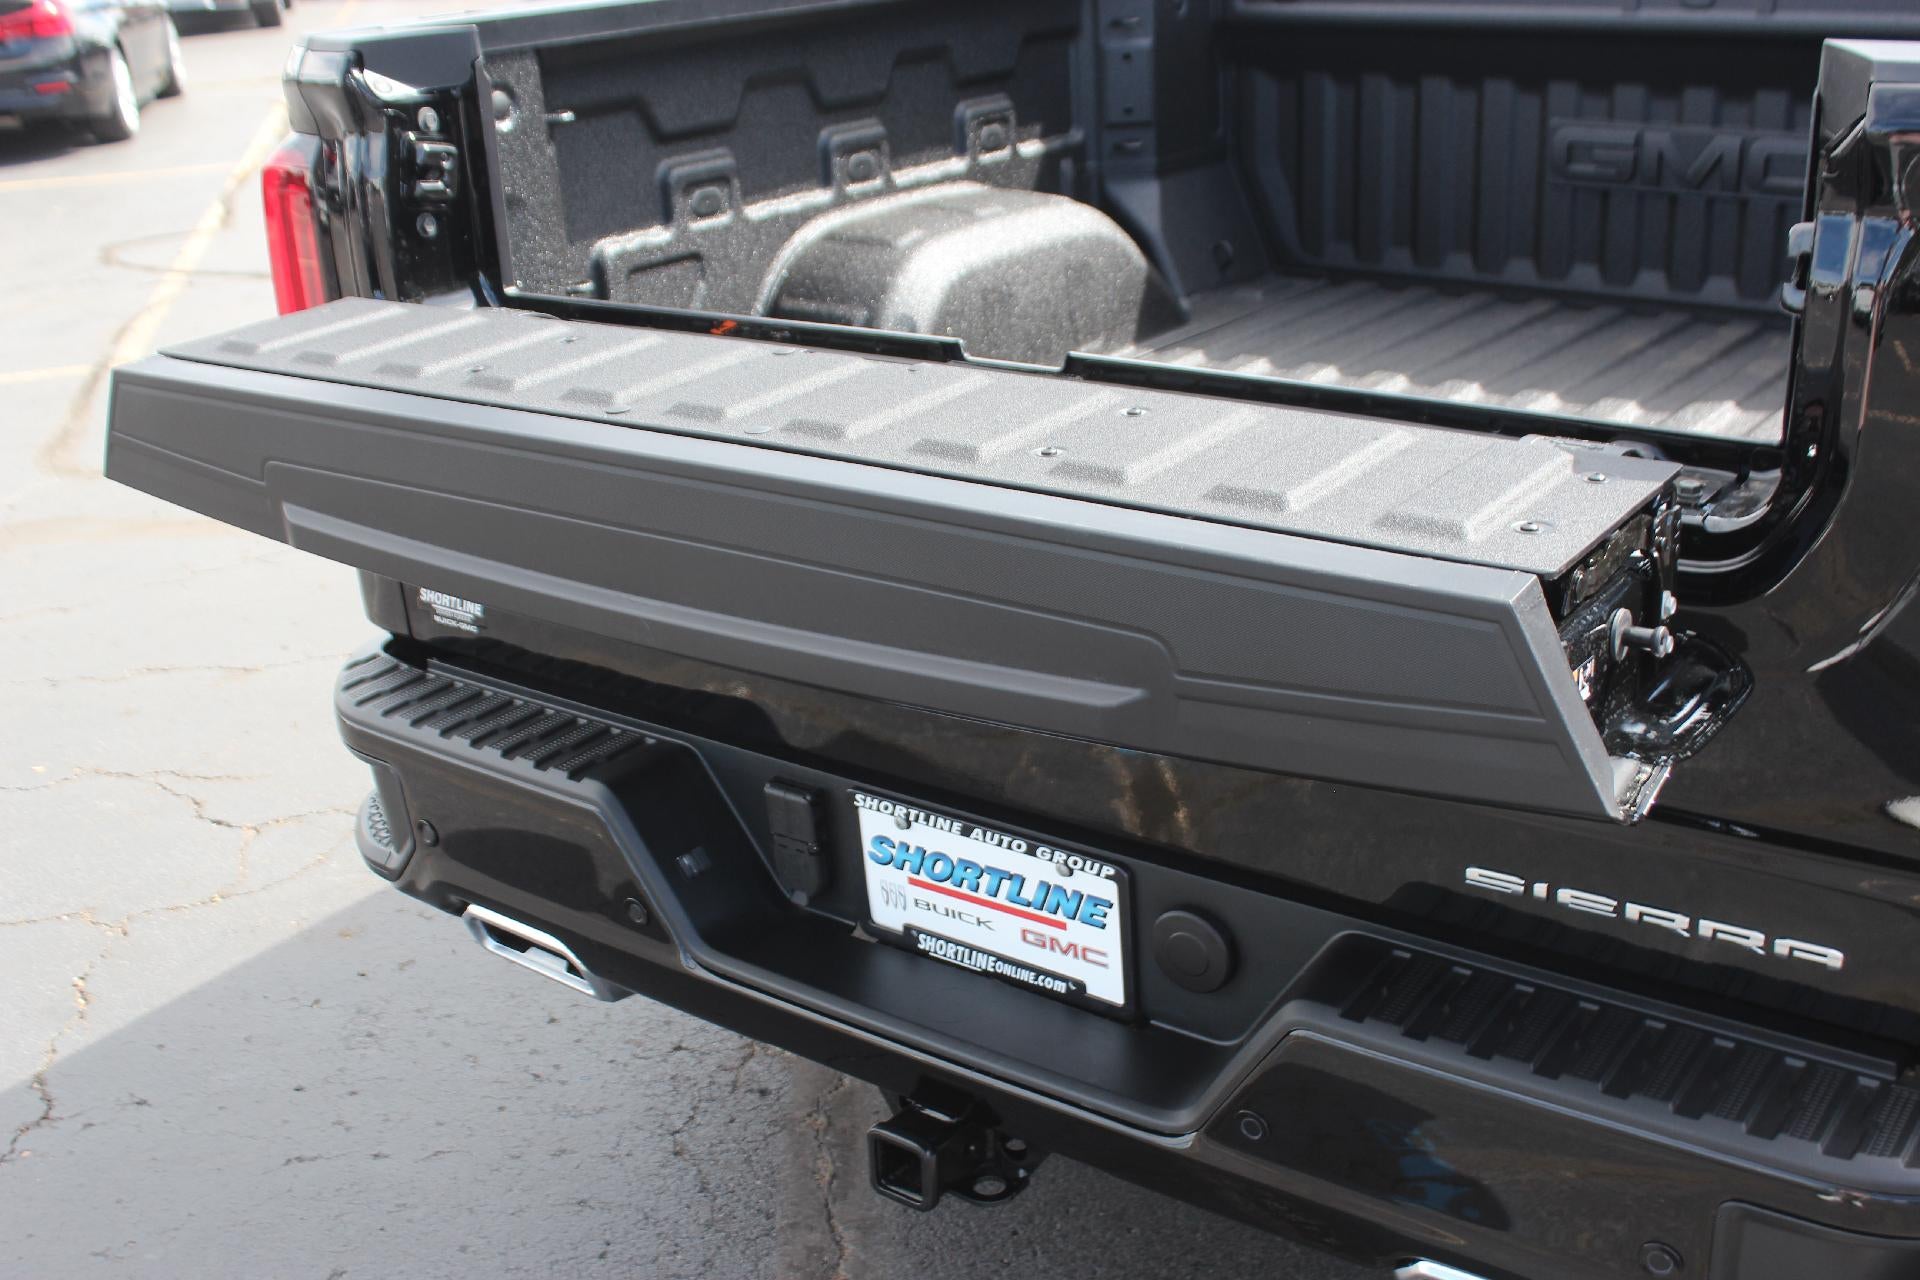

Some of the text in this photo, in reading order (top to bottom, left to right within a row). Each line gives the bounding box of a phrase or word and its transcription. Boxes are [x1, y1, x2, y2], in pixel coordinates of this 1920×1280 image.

[1552, 125, 1808, 188] GMC
[420, 587, 484, 618] SHORTLINE
[854, 793, 1115, 879] SHORTLINE AUTO GROUP
[867, 834, 1114, 930] SHORTLINE
[1465, 866, 1845, 970] SIERRA
[914, 898, 1109, 968] BUICK GMC
